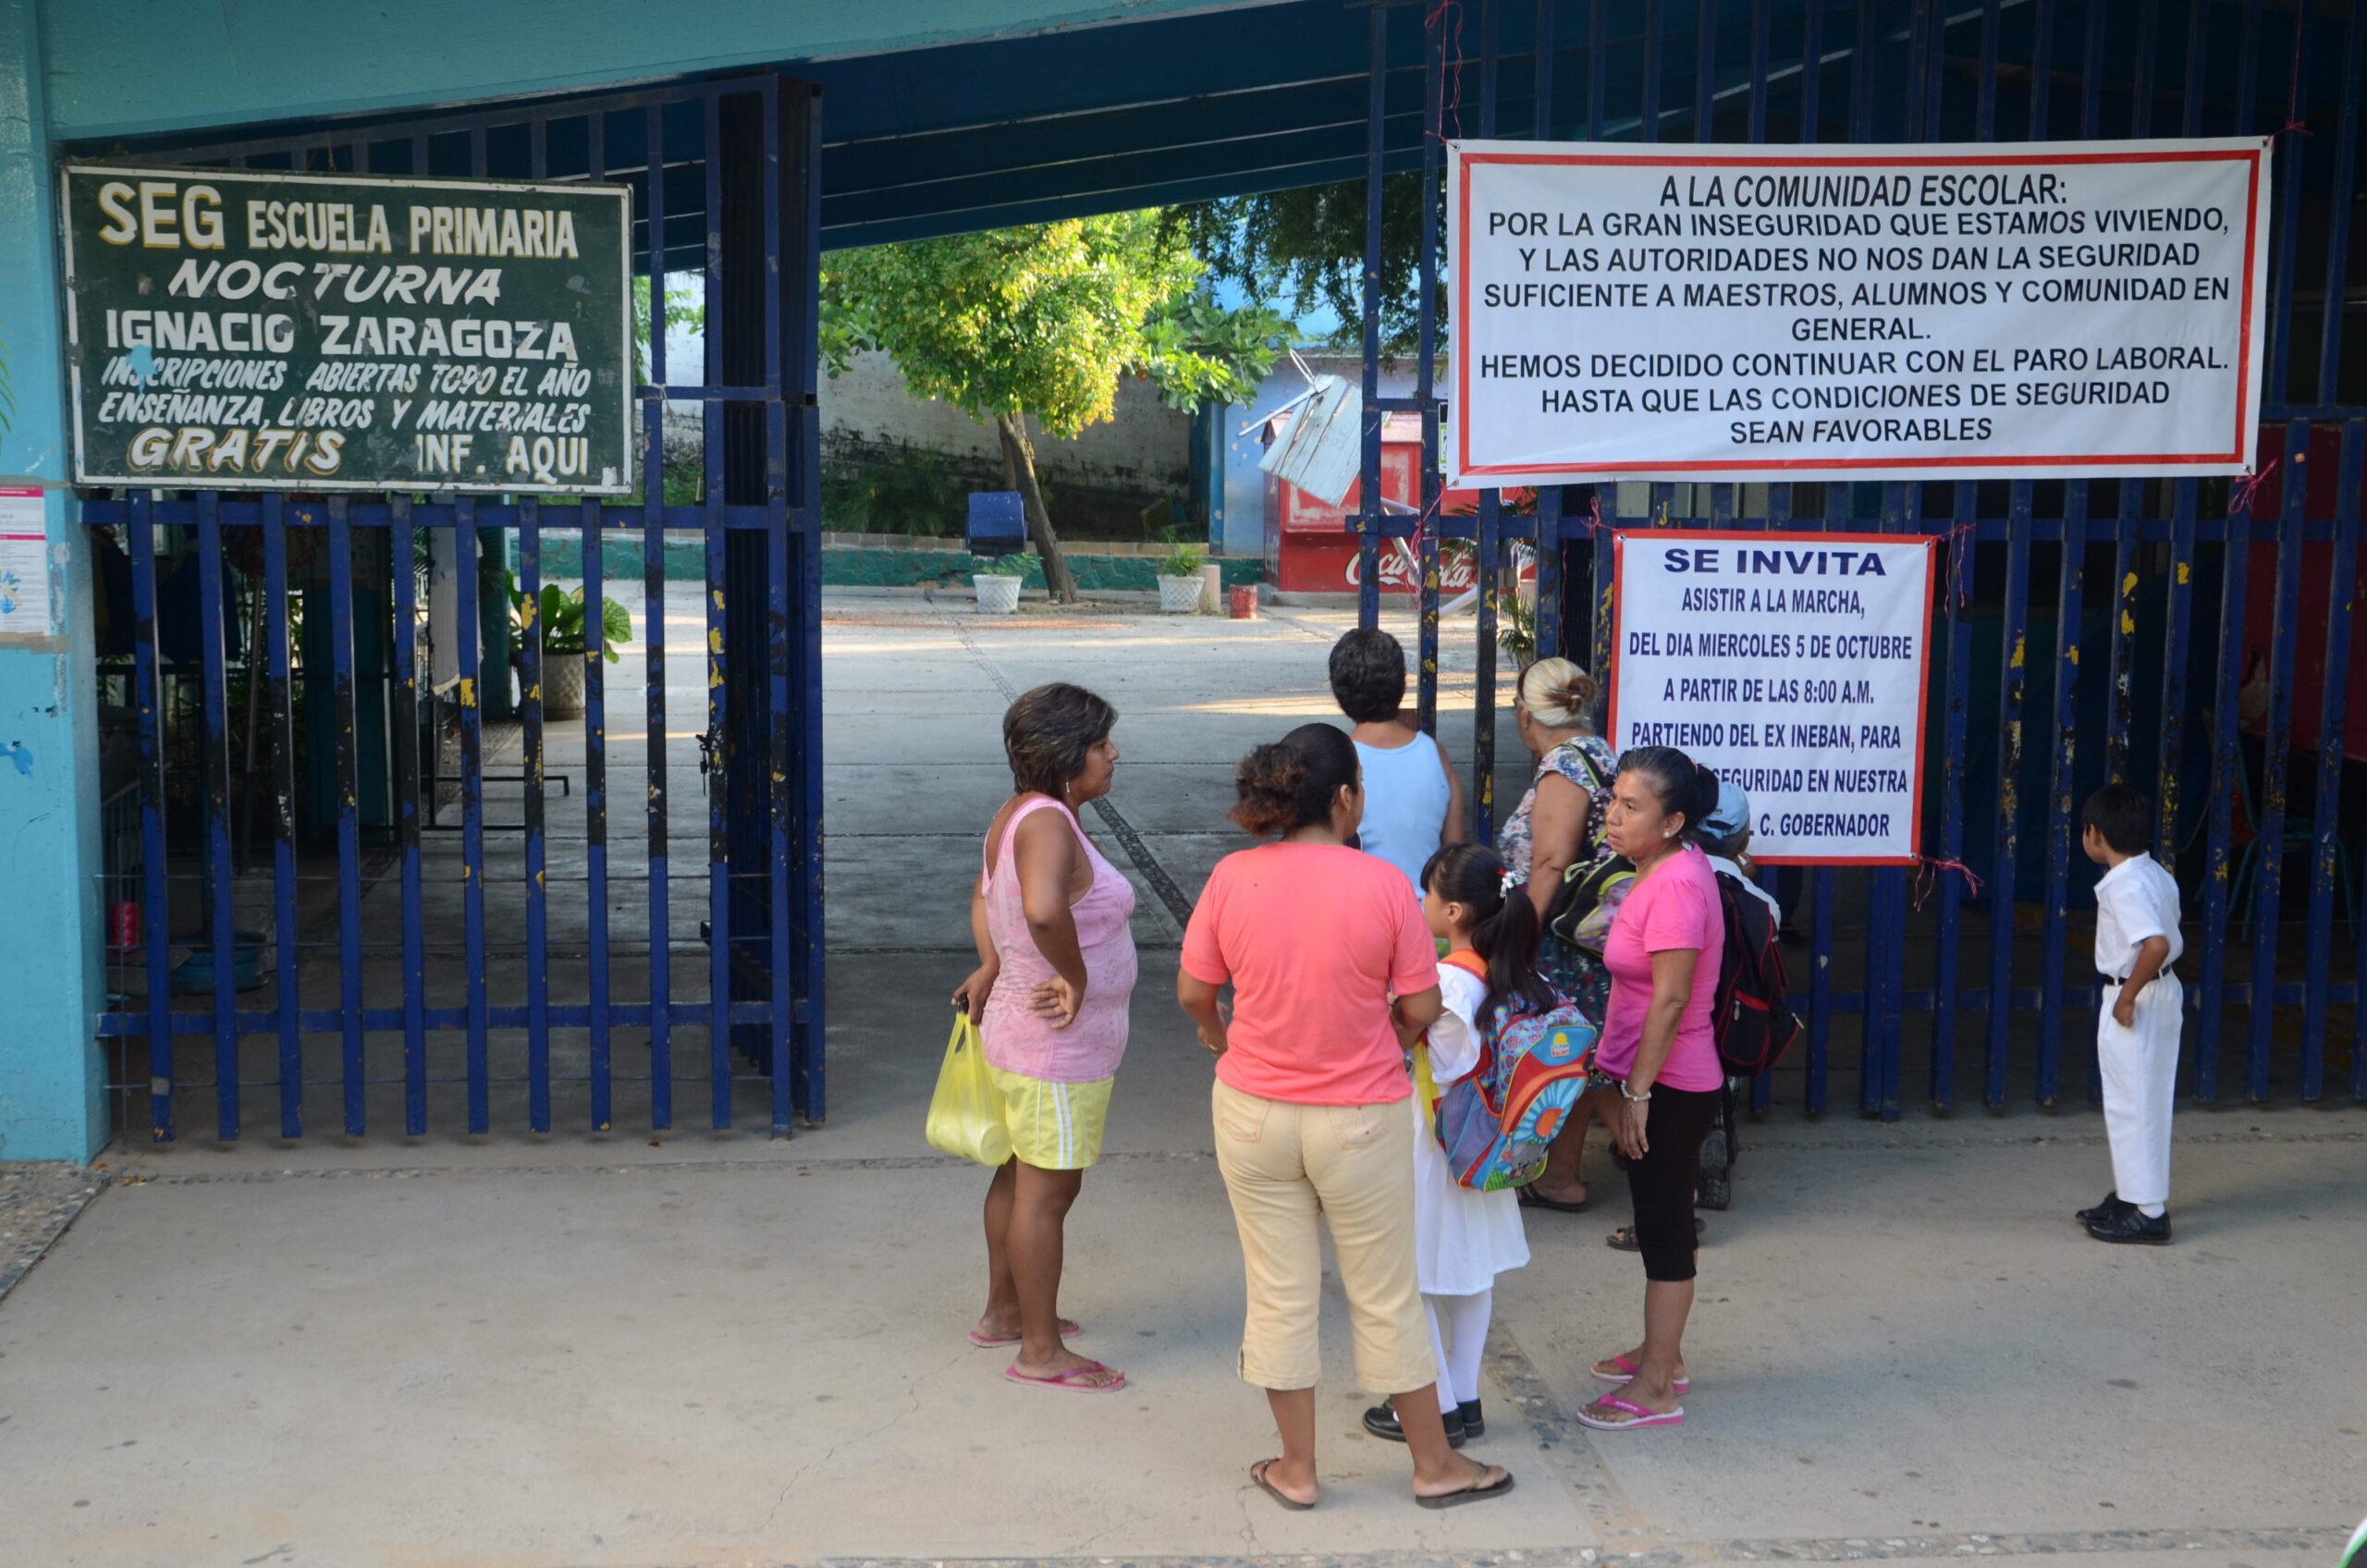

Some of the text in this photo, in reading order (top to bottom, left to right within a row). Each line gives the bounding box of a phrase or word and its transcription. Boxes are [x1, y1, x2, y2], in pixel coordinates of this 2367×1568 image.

[1661, 174, 2066, 207] A LA COMUNIDAD ESCOLAR:
[100, 182, 578, 258] SEG ESCUELA PRIMARIA
[1490, 208, 2227, 237] POR LA GRAN INSEGURIDAD QUE ESTAMOS VIVIENDO,
[1519, 243, 2199, 272] Y LAS AUTORIDADES NO NOS DAN LA SEGURIDAD
[168, 259, 501, 306] NOCTURNA
[1485, 277, 2228, 310] SUFICIENTE A MAESTROS, ALUMNOS Y COMUNIDAD EN
[106, 310, 578, 361] IGNACIO ZARAGOZA
[1792, 318, 1930, 341] GENERAL.
[1482, 347, 2227, 377] HEMOS DECIDIDO CONTINUAR CON EL PARO LABORAL.
[306, 361, 421, 393] ABIERTAS
[500, 367, 528, 396] EL
[537, 362, 591, 397] AÑO
[98, 388, 591, 433] ENSEÑANZA, LIBROS Y MATERIALES
[1543, 382, 2169, 413] HASTA QUE LAS CONDICIONES DE SEGURIDAD
[1731, 418, 1992, 444] SEAN FAVORABLES
[129, 429, 589, 485] GRATIS INF. AQUI
[1664, 549, 1885, 576] SE INVITA
[1682, 588, 1864, 619] ASISTIR A LA MARCHA,
[1630, 632, 1911, 659] DEL DIA MIERCOLES 5 DE OCTUBRE
[1663, 679, 1873, 704] A PARTIR DE LAS 8:00 A.M.
[1633, 723, 1900, 753] PARTIENDO DEL EX INEBAN, PARA
[1712, 768, 1907, 792] EGURIDAD EN NUESTRA
[1760, 814, 1889, 837] C. GOBERNADOR
